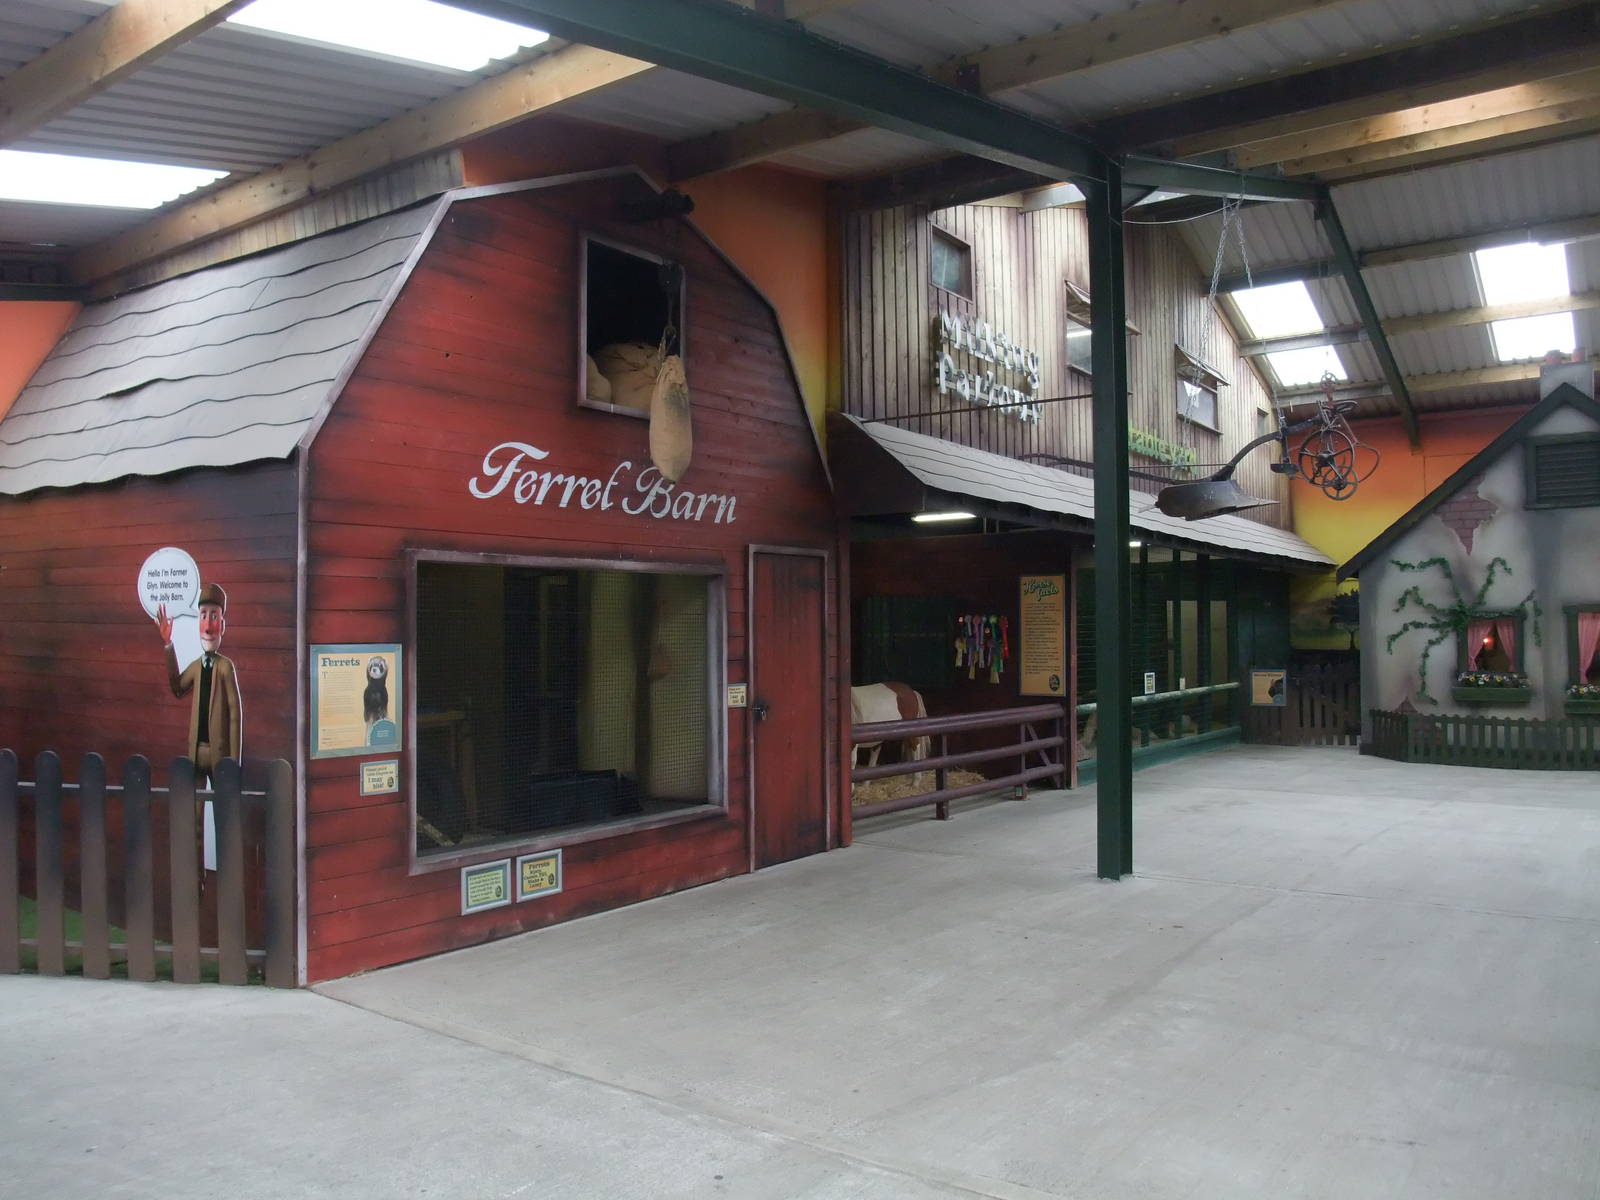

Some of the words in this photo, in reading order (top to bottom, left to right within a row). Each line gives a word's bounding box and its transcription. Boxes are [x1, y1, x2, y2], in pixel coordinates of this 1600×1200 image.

[939, 304, 1041, 389] Milking
[937, 350, 1043, 424] Parlour
[468, 441, 632, 512] Ferret
[621, 465, 738, 525] Barn
[161, 569, 169, 577] I'm
[170, 568, 188, 577] Farmer
[160, 581, 182, 589] Welcome
[159, 593, 170, 603] Jolly
[321, 657, 361, 668] Ferrets
